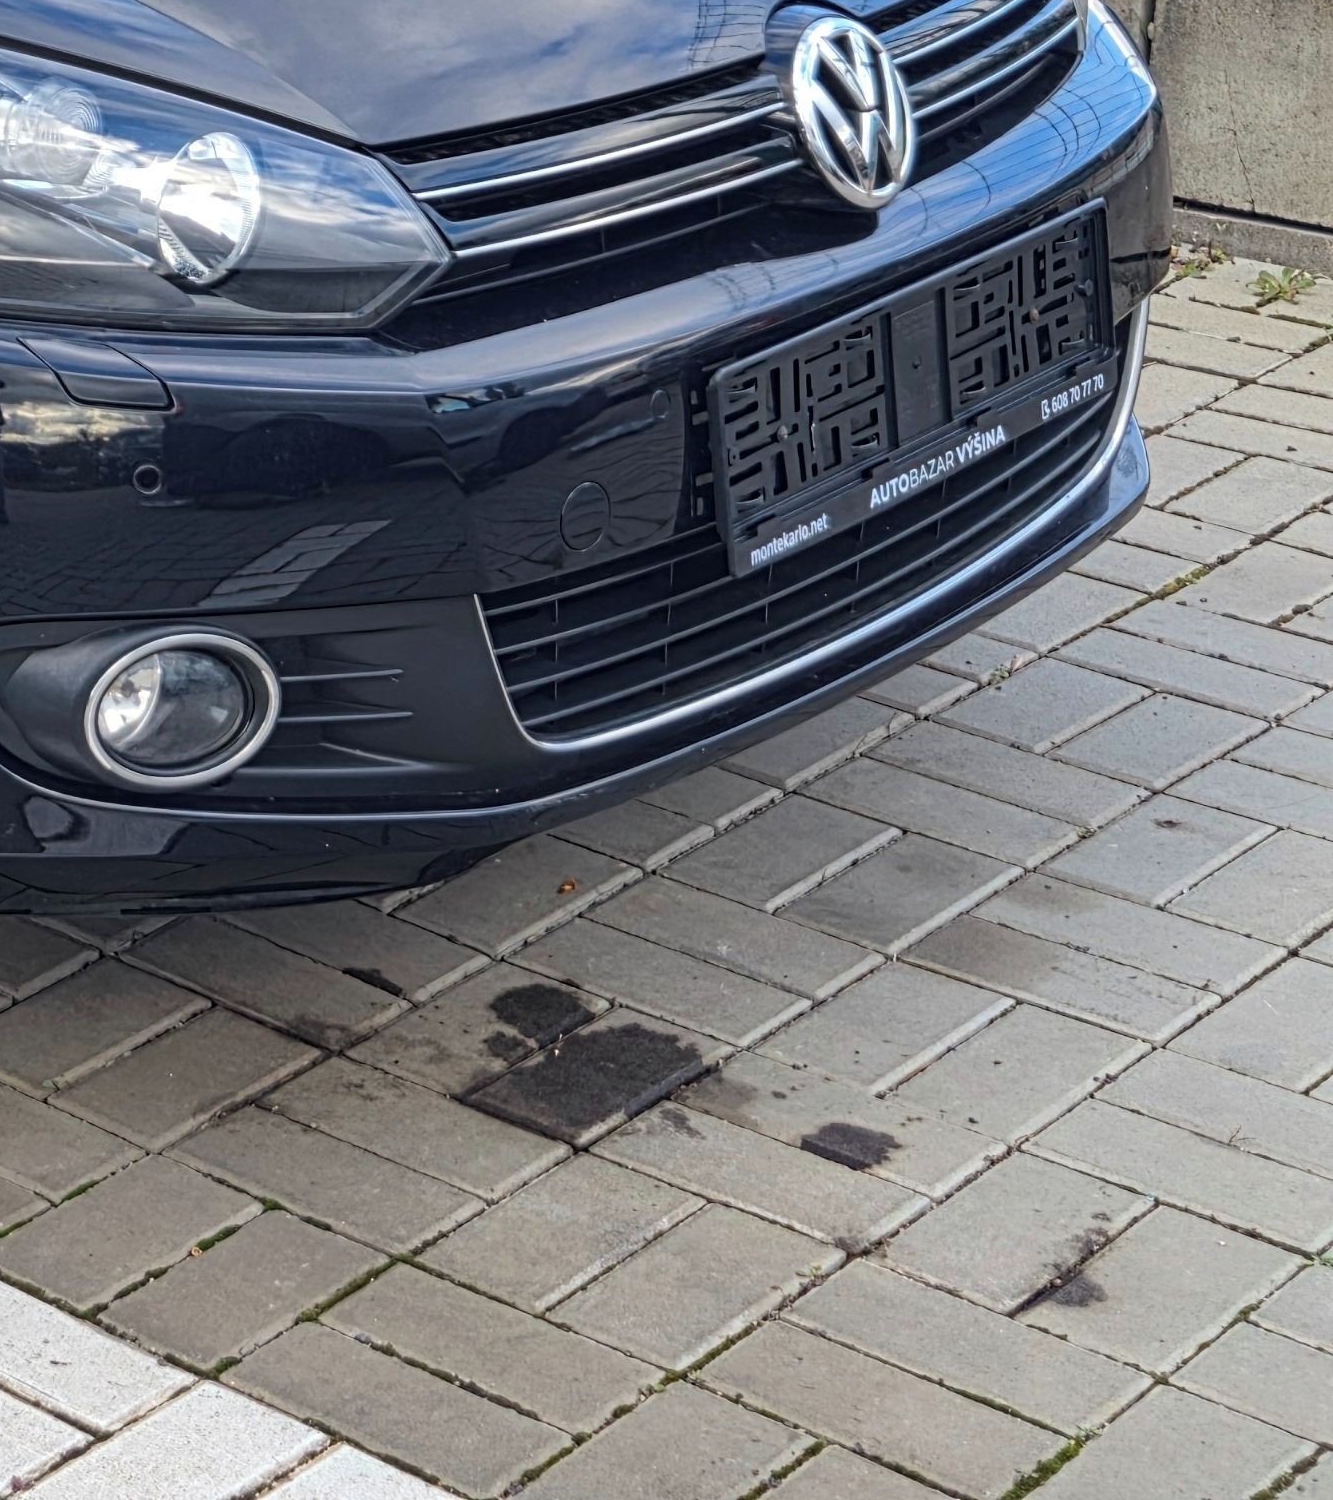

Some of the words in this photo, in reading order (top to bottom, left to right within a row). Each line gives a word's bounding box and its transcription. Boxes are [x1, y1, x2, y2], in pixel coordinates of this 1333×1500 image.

[796, 18, 911, 204] VW
[1051, 391, 1069, 413] 608
[1069, 385, 1081, 404] 70
[1081, 378, 1092, 398] 77
[1093, 372, 1104, 392] 70
[870, 450, 955, 509] AUTOBAZAR
[956, 424, 1006, 464] VÝŠINA
[750, 512, 829, 567] montekarlo.net
